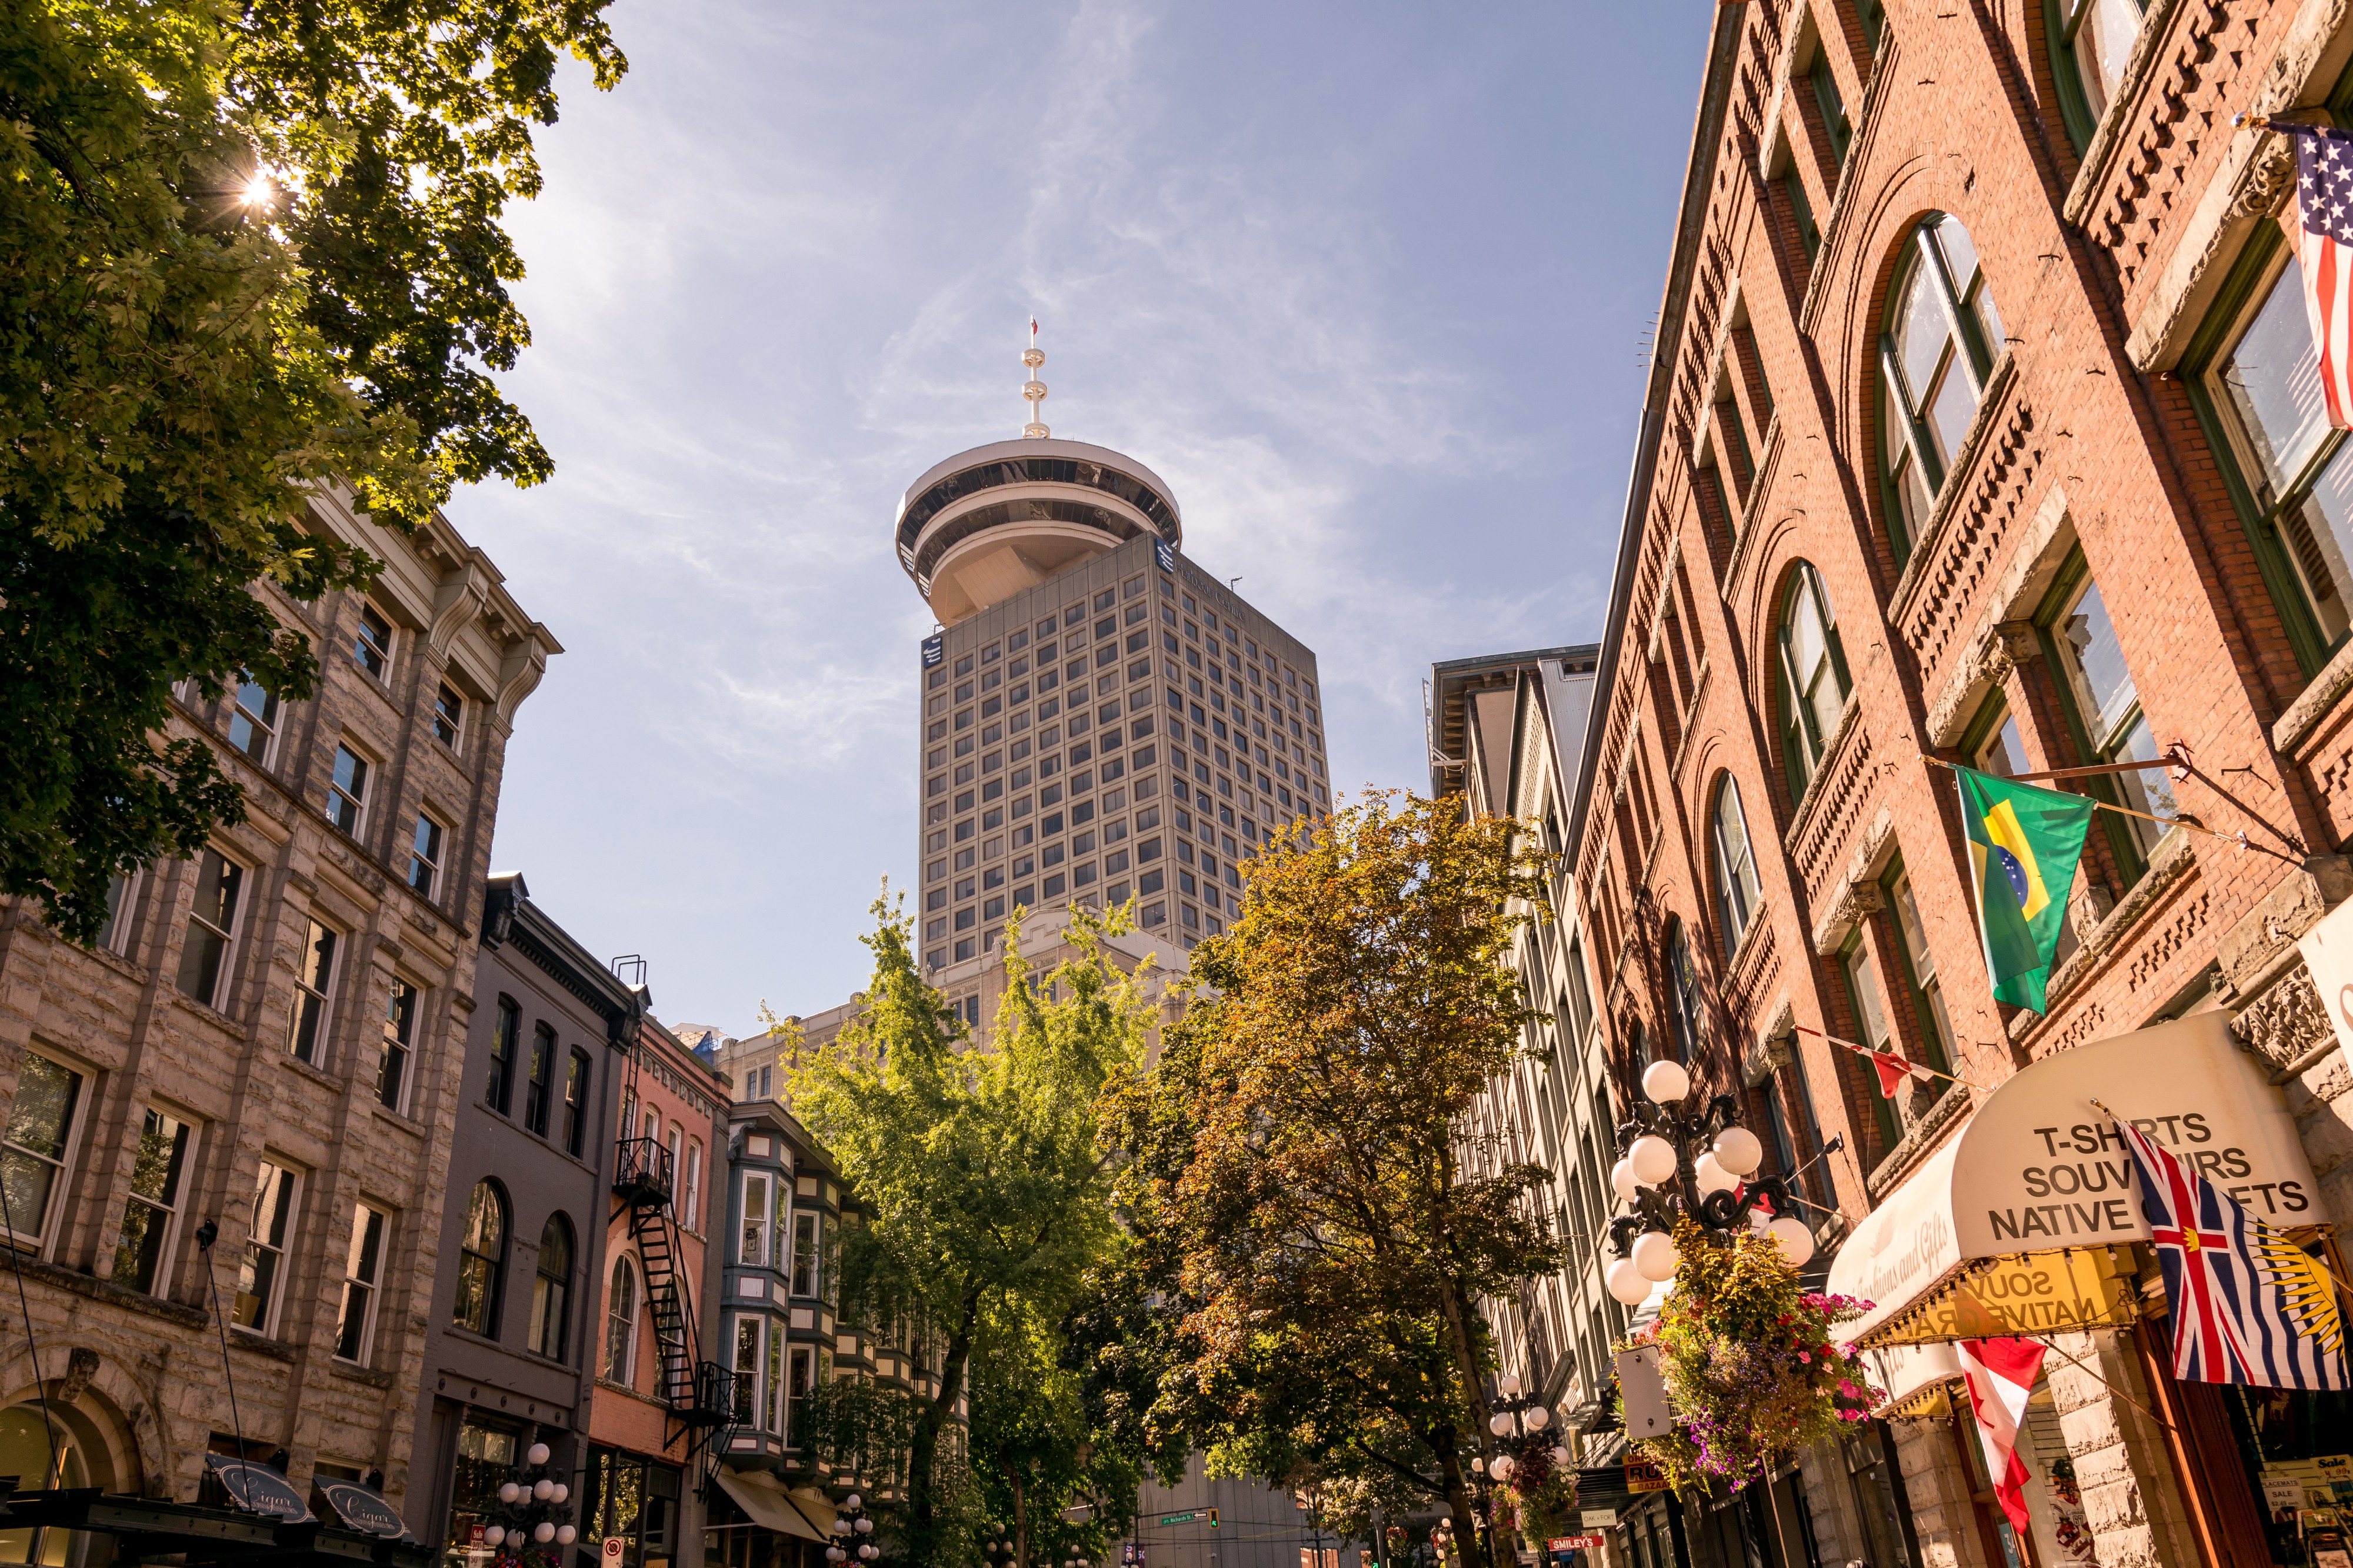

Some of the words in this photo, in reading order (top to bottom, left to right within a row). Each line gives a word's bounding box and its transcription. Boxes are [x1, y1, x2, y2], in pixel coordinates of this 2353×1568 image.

[1175, 559, 1212, 598] Harbour
[1215, 592, 1245, 622] Centre
[2033, 1112, 2211, 1157] T-SHRTS
[2022, 1147, 2251, 1197] SOUVIRS
[1988, 1199, 2135, 1240] NATIVE
[1857, 1265, 1899, 1303] Fashions
[1899, 1229, 1921, 1284] and
[1920, 1211, 1948, 1277] Gifts
[2318, 1457, 2346, 1468] Sale
[231, 1473, 294, 1513] Cigar
[336, 1492, 391, 1529] Cigar
[473, 1530, 483, 1539] Sale
[2073, 1515, 2083, 1526] 67
[1553, 1536, 1594, 1549] SMILEY'S
